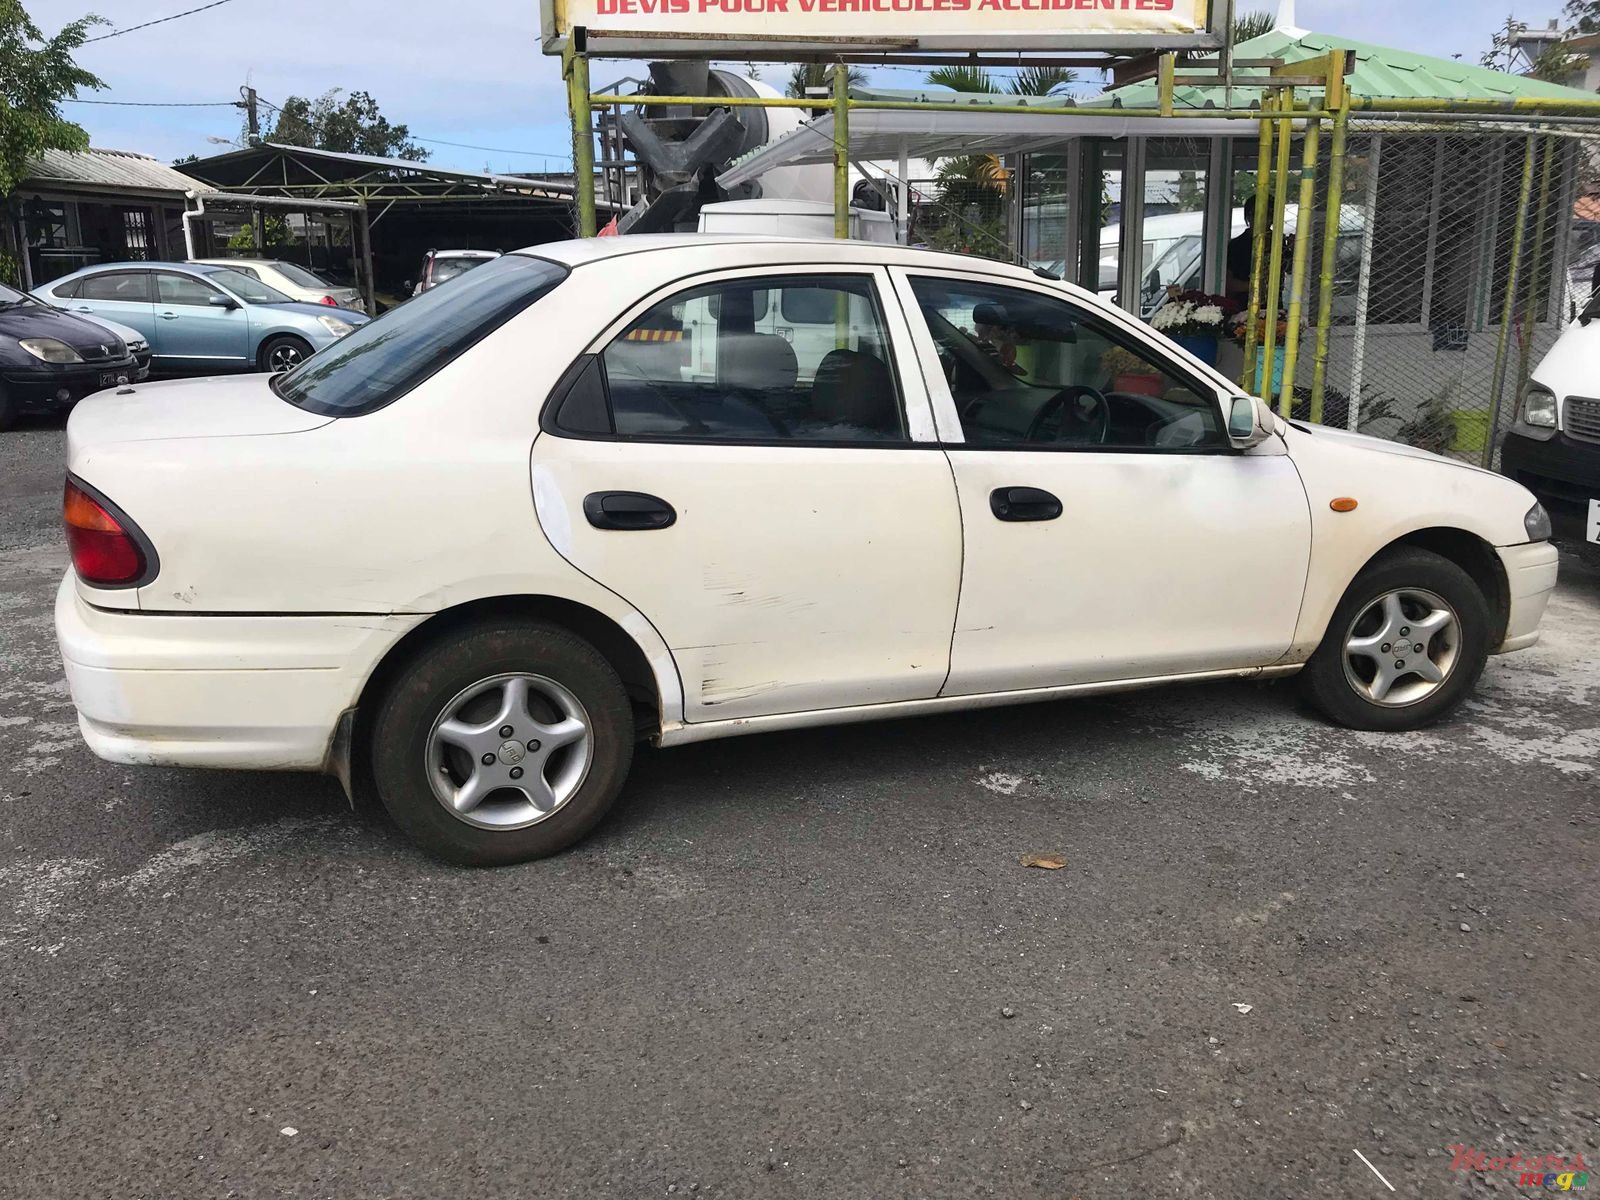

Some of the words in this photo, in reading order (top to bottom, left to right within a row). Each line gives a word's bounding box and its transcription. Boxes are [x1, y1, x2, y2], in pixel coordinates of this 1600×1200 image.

[597, 0, 689, 14] DEVIS
[699, 0, 789, 13] POUR
[798, 0, 971, 12] VEHICULES
[978, 0, 1174, 11] ACCIDENTES
